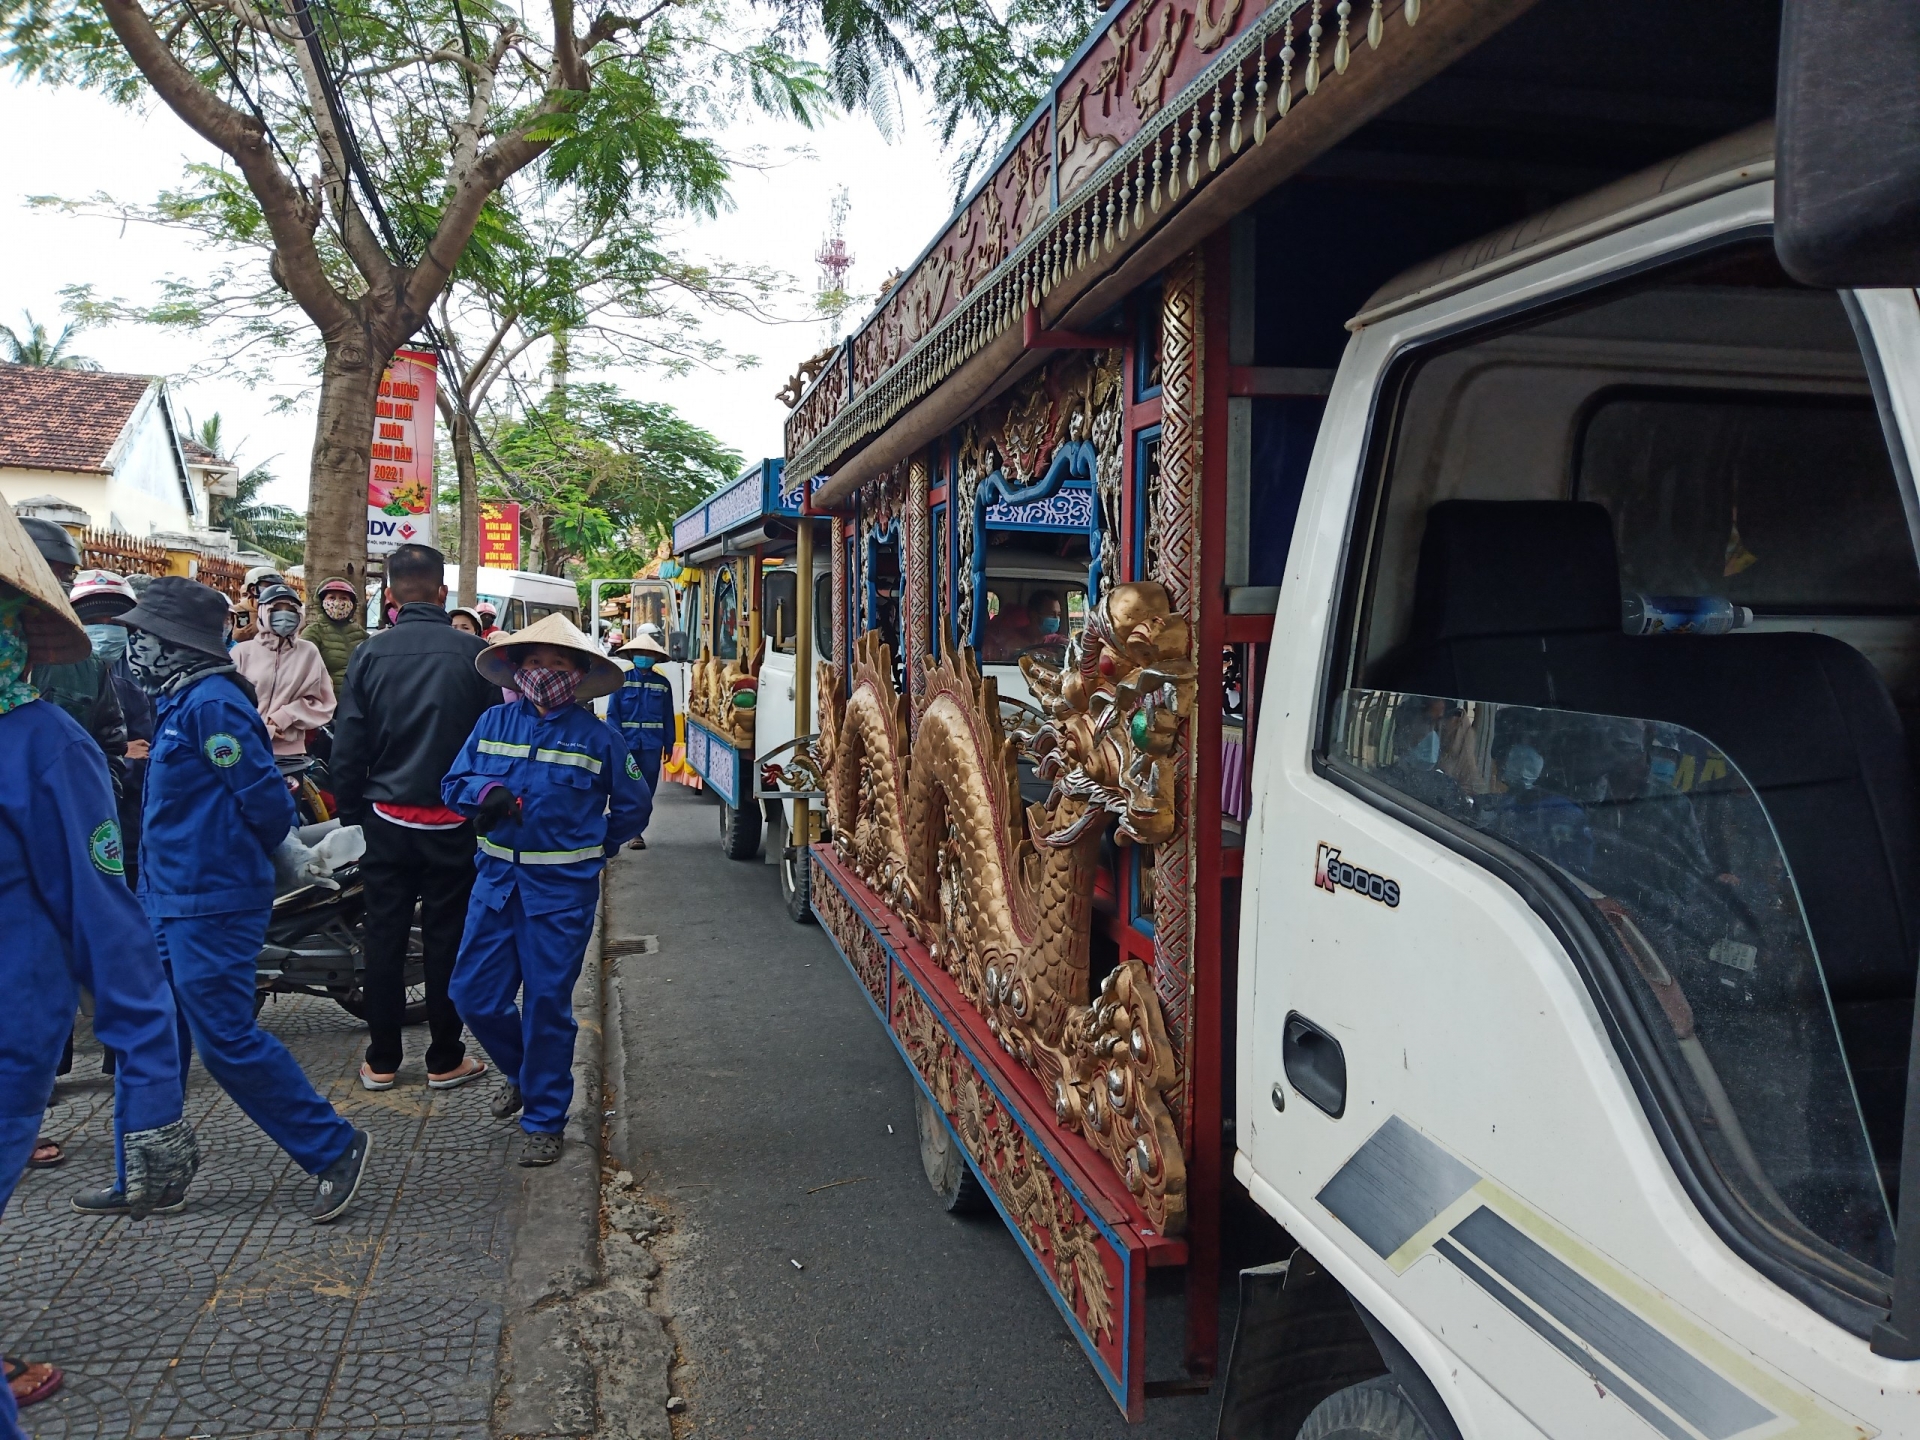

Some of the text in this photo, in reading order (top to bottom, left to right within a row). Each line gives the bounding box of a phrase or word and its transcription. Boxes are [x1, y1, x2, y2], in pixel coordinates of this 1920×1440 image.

[378, 379, 419, 401] ÚC MỪNG
[379, 422, 404, 441] XUÂN
[370, 441, 392, 461] HÂM
[374, 465, 398, 482] 2022
[1314, 843, 1401, 908] K3000S
